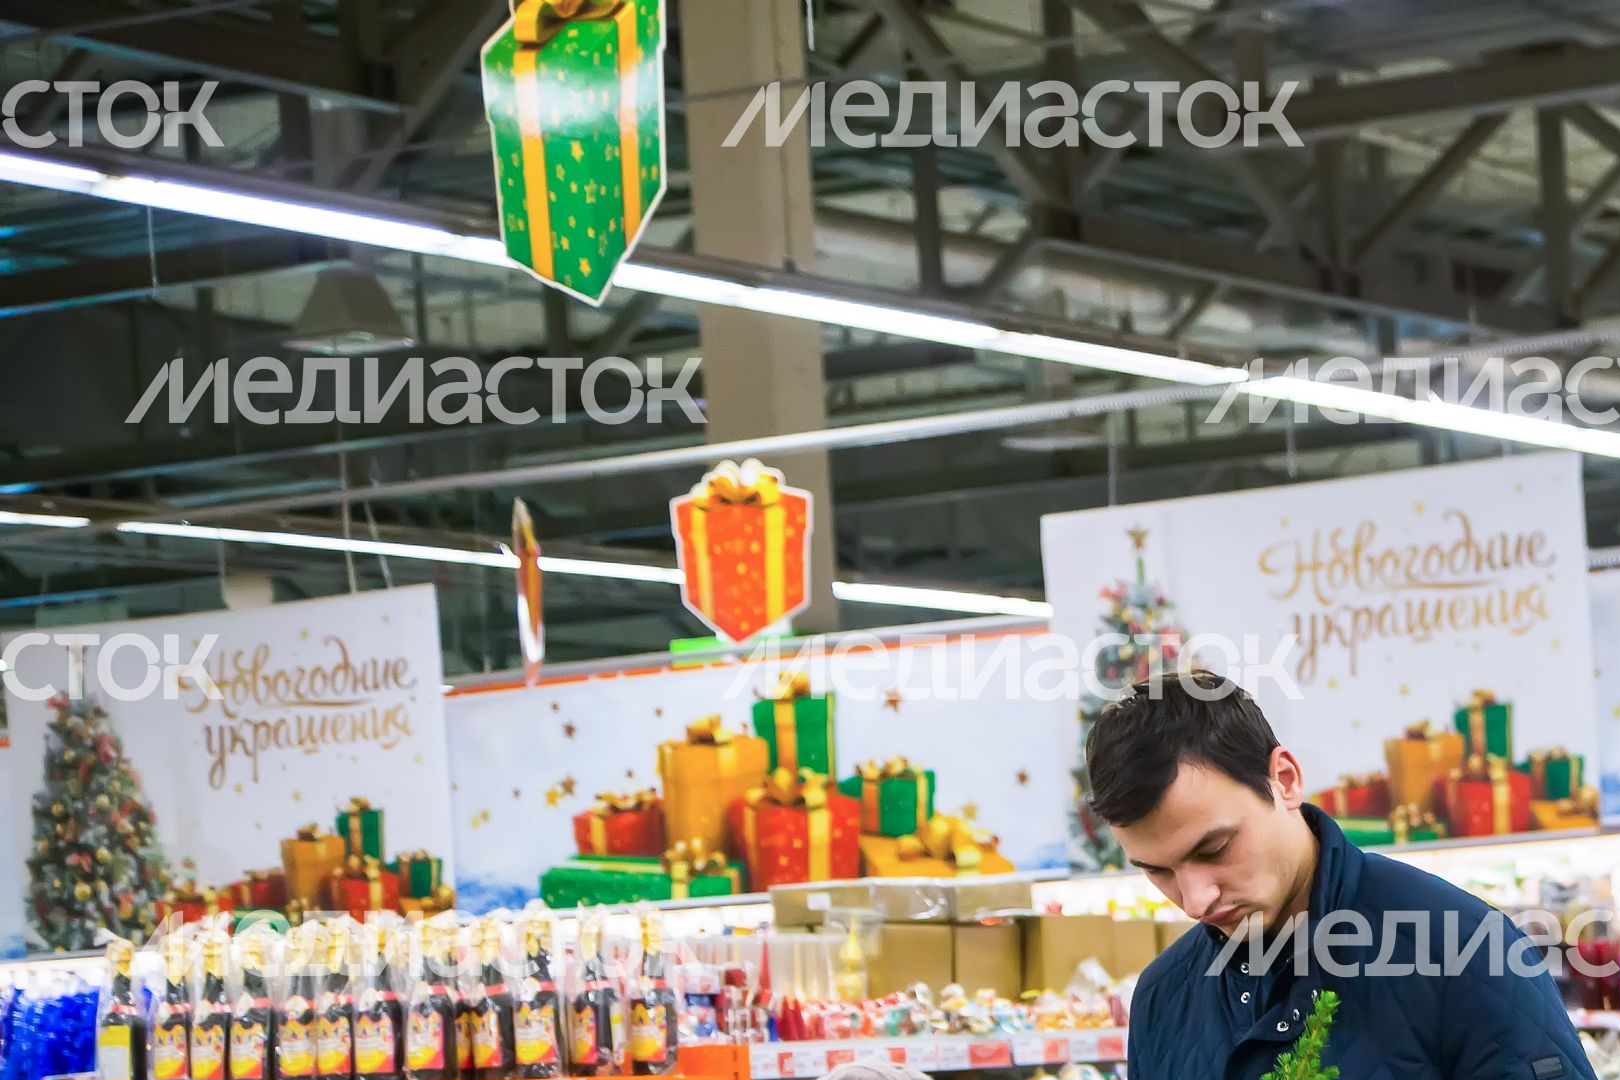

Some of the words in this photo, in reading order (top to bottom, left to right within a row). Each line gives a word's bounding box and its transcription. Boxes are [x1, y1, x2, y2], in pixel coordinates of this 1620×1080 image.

[1257, 507, 1556, 607] Новогодние
[177, 635, 418, 719] Новогодние
[1292, 582, 1549, 686] украшения
[205, 703, 414, 790] украшения
